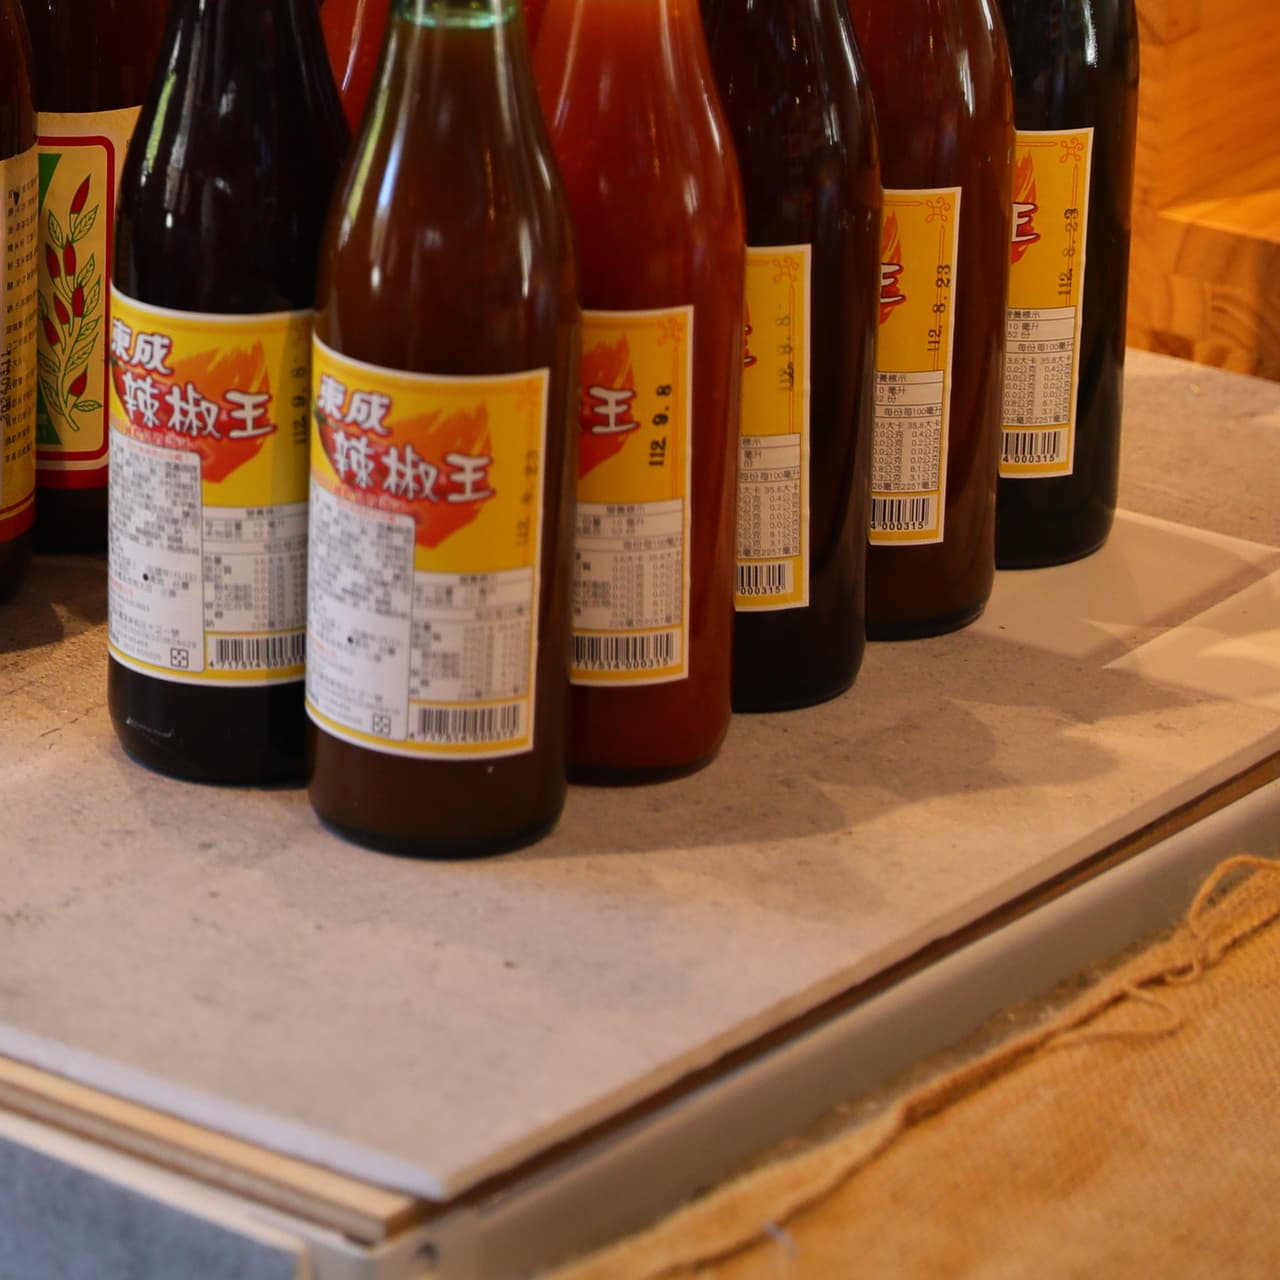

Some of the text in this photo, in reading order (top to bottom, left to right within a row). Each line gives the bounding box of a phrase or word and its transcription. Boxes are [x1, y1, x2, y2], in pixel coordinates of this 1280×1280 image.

[935, 264, 951, 288] 23
[110, 318, 172, 376] 東成
[122, 372, 276, 440] 辣椒王
[317, 375, 392, 435] 東成
[589, 385, 641, 435] 王
[657, 384, 672, 397] 8
[331, 430, 496, 504] 辣椒王
[1014, 455, 1055, 463] 000315
[882, 521, 924, 530] 000315
